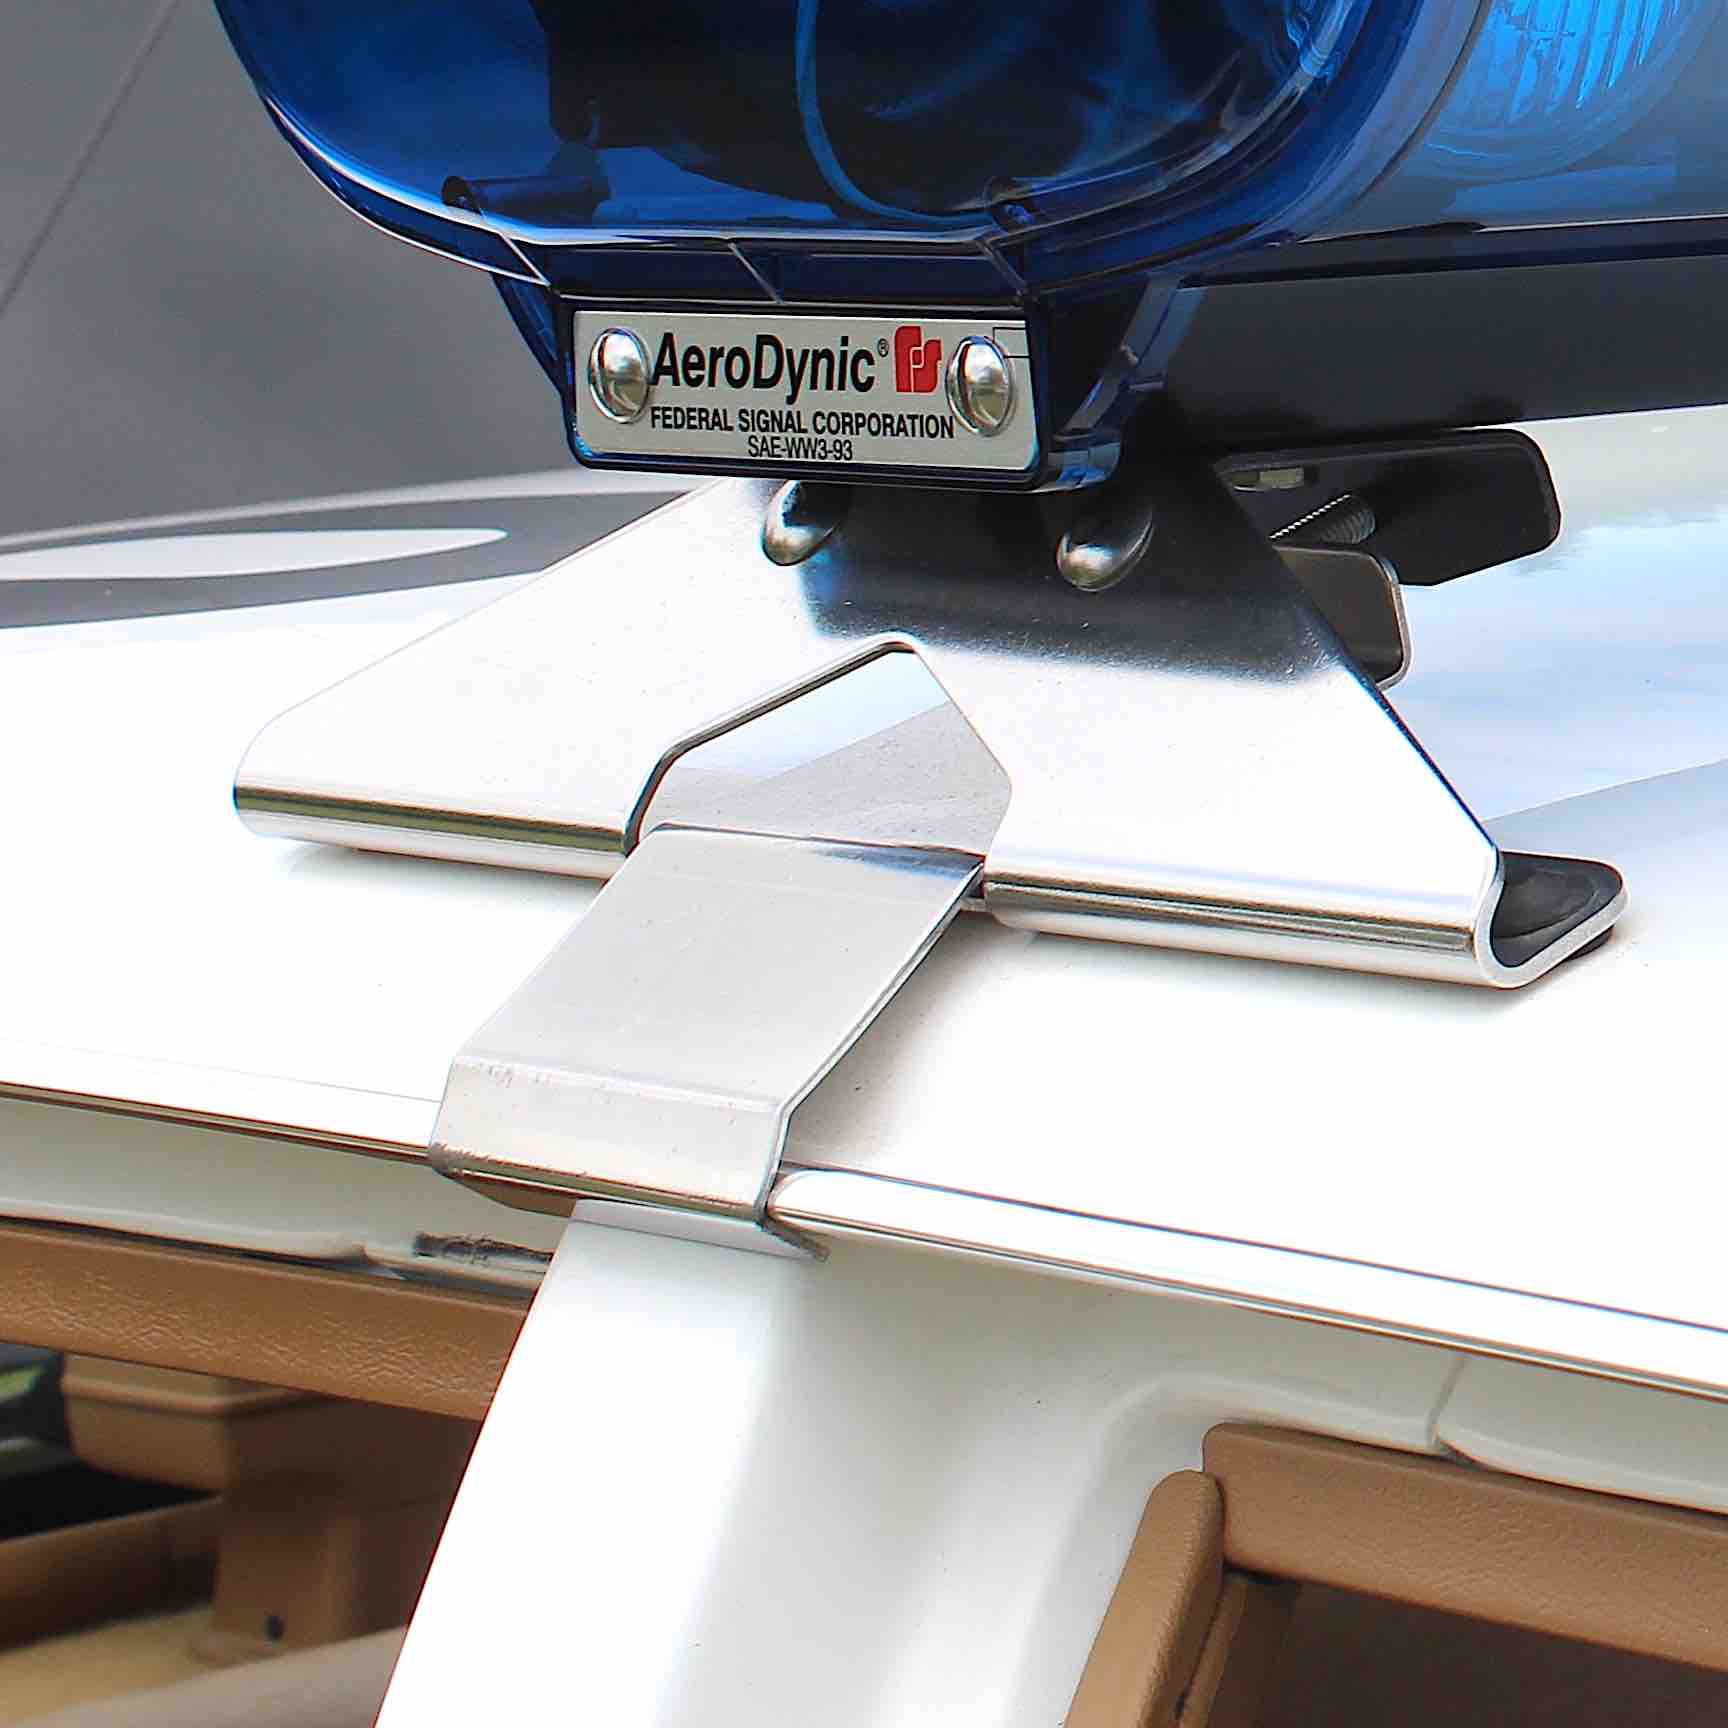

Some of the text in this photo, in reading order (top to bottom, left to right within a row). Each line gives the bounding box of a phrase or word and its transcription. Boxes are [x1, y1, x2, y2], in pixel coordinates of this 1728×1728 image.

[651, 406, 955, 439] FEDERAL SIGNAL CORPORATION
[747, 435, 853, 461] SAE-WW3-93
